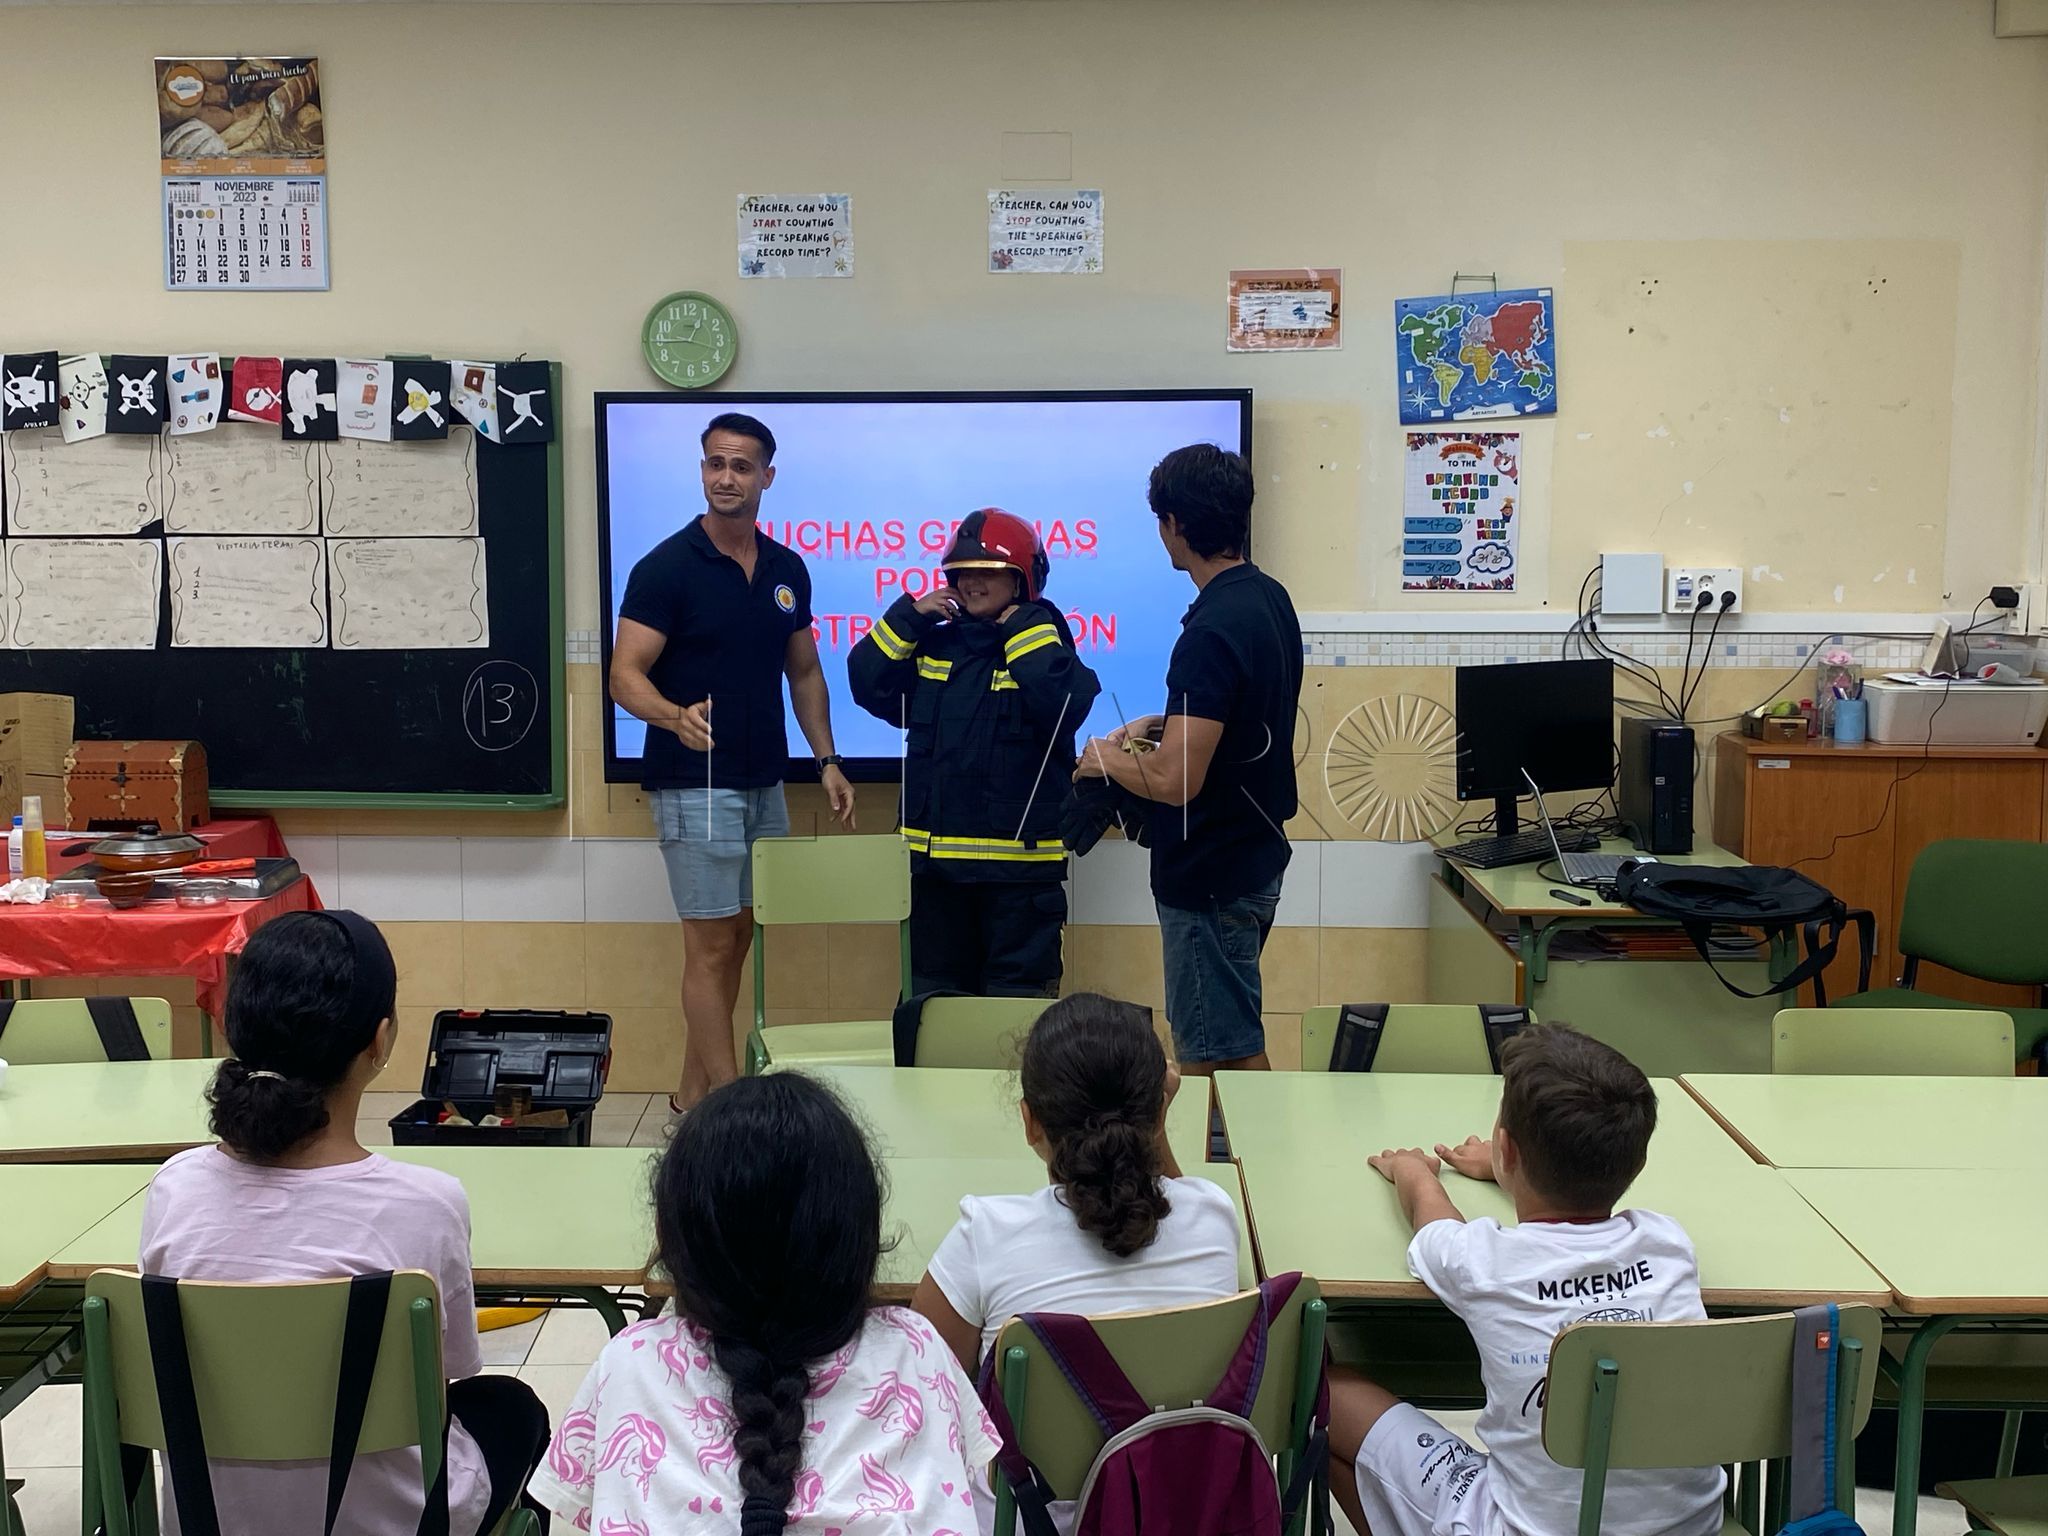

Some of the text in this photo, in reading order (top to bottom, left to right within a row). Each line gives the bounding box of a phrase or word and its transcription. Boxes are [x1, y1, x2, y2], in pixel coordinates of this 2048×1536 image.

[241, 74, 258, 85] pan
[261, 70, 280, 80] bien
[214, 182, 274, 191] NOVIEMBRE
[233, 192, 256, 202] 2023
[749, 203, 838, 213] TEACHER, CAN YOU
[999, 200, 1092, 211] TEACHER, CAN YOU
[219, 208, 307, 220] 1 2 3 4 5
[753, 218, 834, 228] START COUNTING
[1006, 216, 1085, 226] STOP COUNTING
[177, 224, 310, 236] 6 7 8 9 10 11 12
[758, 233, 775, 242] THE
[1008, 232, 1026, 241] THE
[176, 239, 310, 252] 13 14 15 16 17 18 19
[757, 248, 794, 257] RECORD
[1007, 247, 1045, 257] RECORD
[176, 255, 312, 267] 20 21 22 23 24 25 26
[176, 270, 249, 282] 27 28 29 30
[669, 308, 680, 320] 11
[683, 303, 696, 316] 12
[702, 308, 707, 320] 1
[659, 320, 671, 333] 10
[712, 319, 719, 331] 2
[716, 334, 724, 347] 3
[661, 349, 668, 361] 8
[712, 349, 720, 362] 4
[672, 361, 679, 373] 7
[687, 364, 694, 377] 6
[702, 361, 710, 373] 5
[1426, 473, 1498, 486] SPEAKING
[1432, 487, 1489, 500] RECORD
[1442, 502, 1475, 514] TIME
[1477, 519, 1506, 528] BEST
[755, 520, 906, 550] UCHAS
[1477, 530, 1506, 540] MARK
[1538, 1260, 1653, 1300] MCKENZIE
